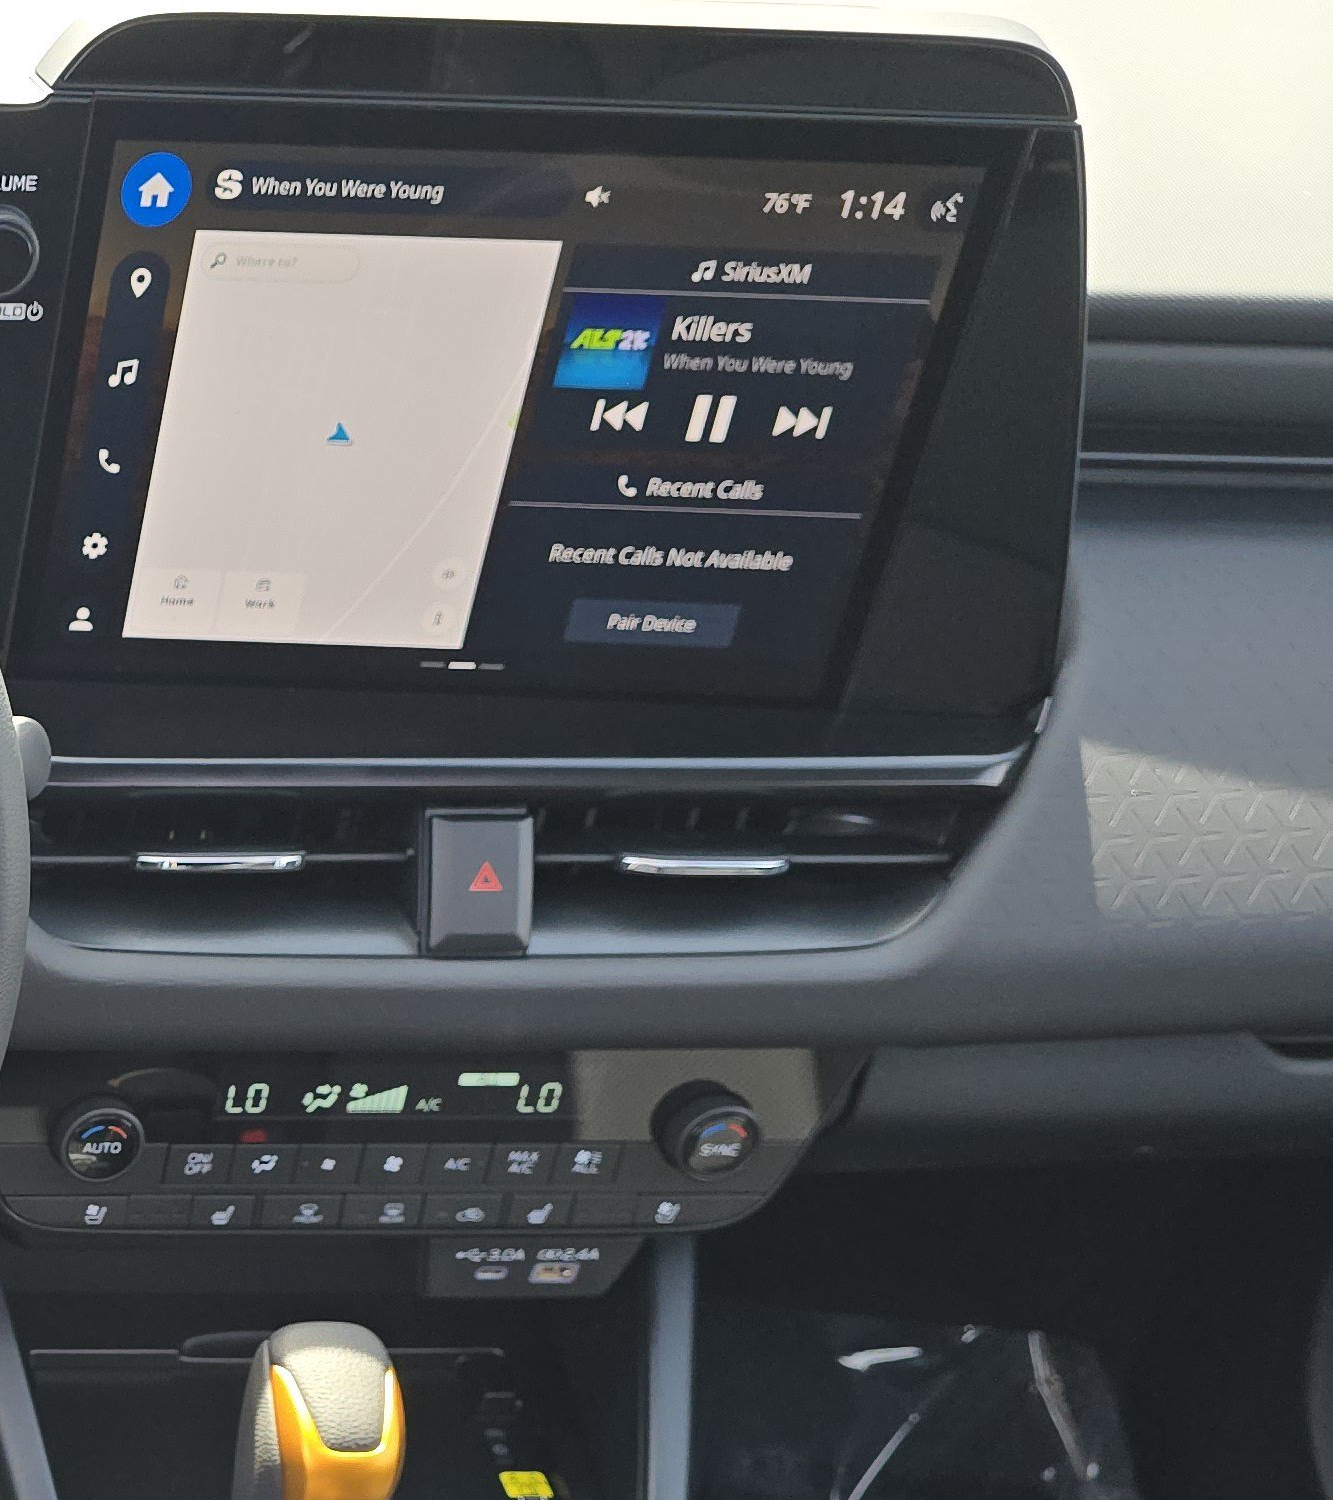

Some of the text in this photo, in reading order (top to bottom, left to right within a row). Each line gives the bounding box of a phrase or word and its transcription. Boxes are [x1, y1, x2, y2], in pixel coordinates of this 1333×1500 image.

[252, 176, 302, 197] When
[305, 178, 338, 198] You
[340, 179, 385, 199] Were
[390, 181, 444, 204] Young
[840, 190, 907, 221] 1:14
[721, 262, 813, 285] SiriusXM
[672, 316, 753, 343] Killers
[663, 353, 854, 381] When You Were Young
[646, 477, 764, 500] Recent Calls
[549, 544, 793, 572] Recent Calls Not Available
[606, 613, 697, 634] Pair Device
[82, 1141, 122, 1155] AUTO
